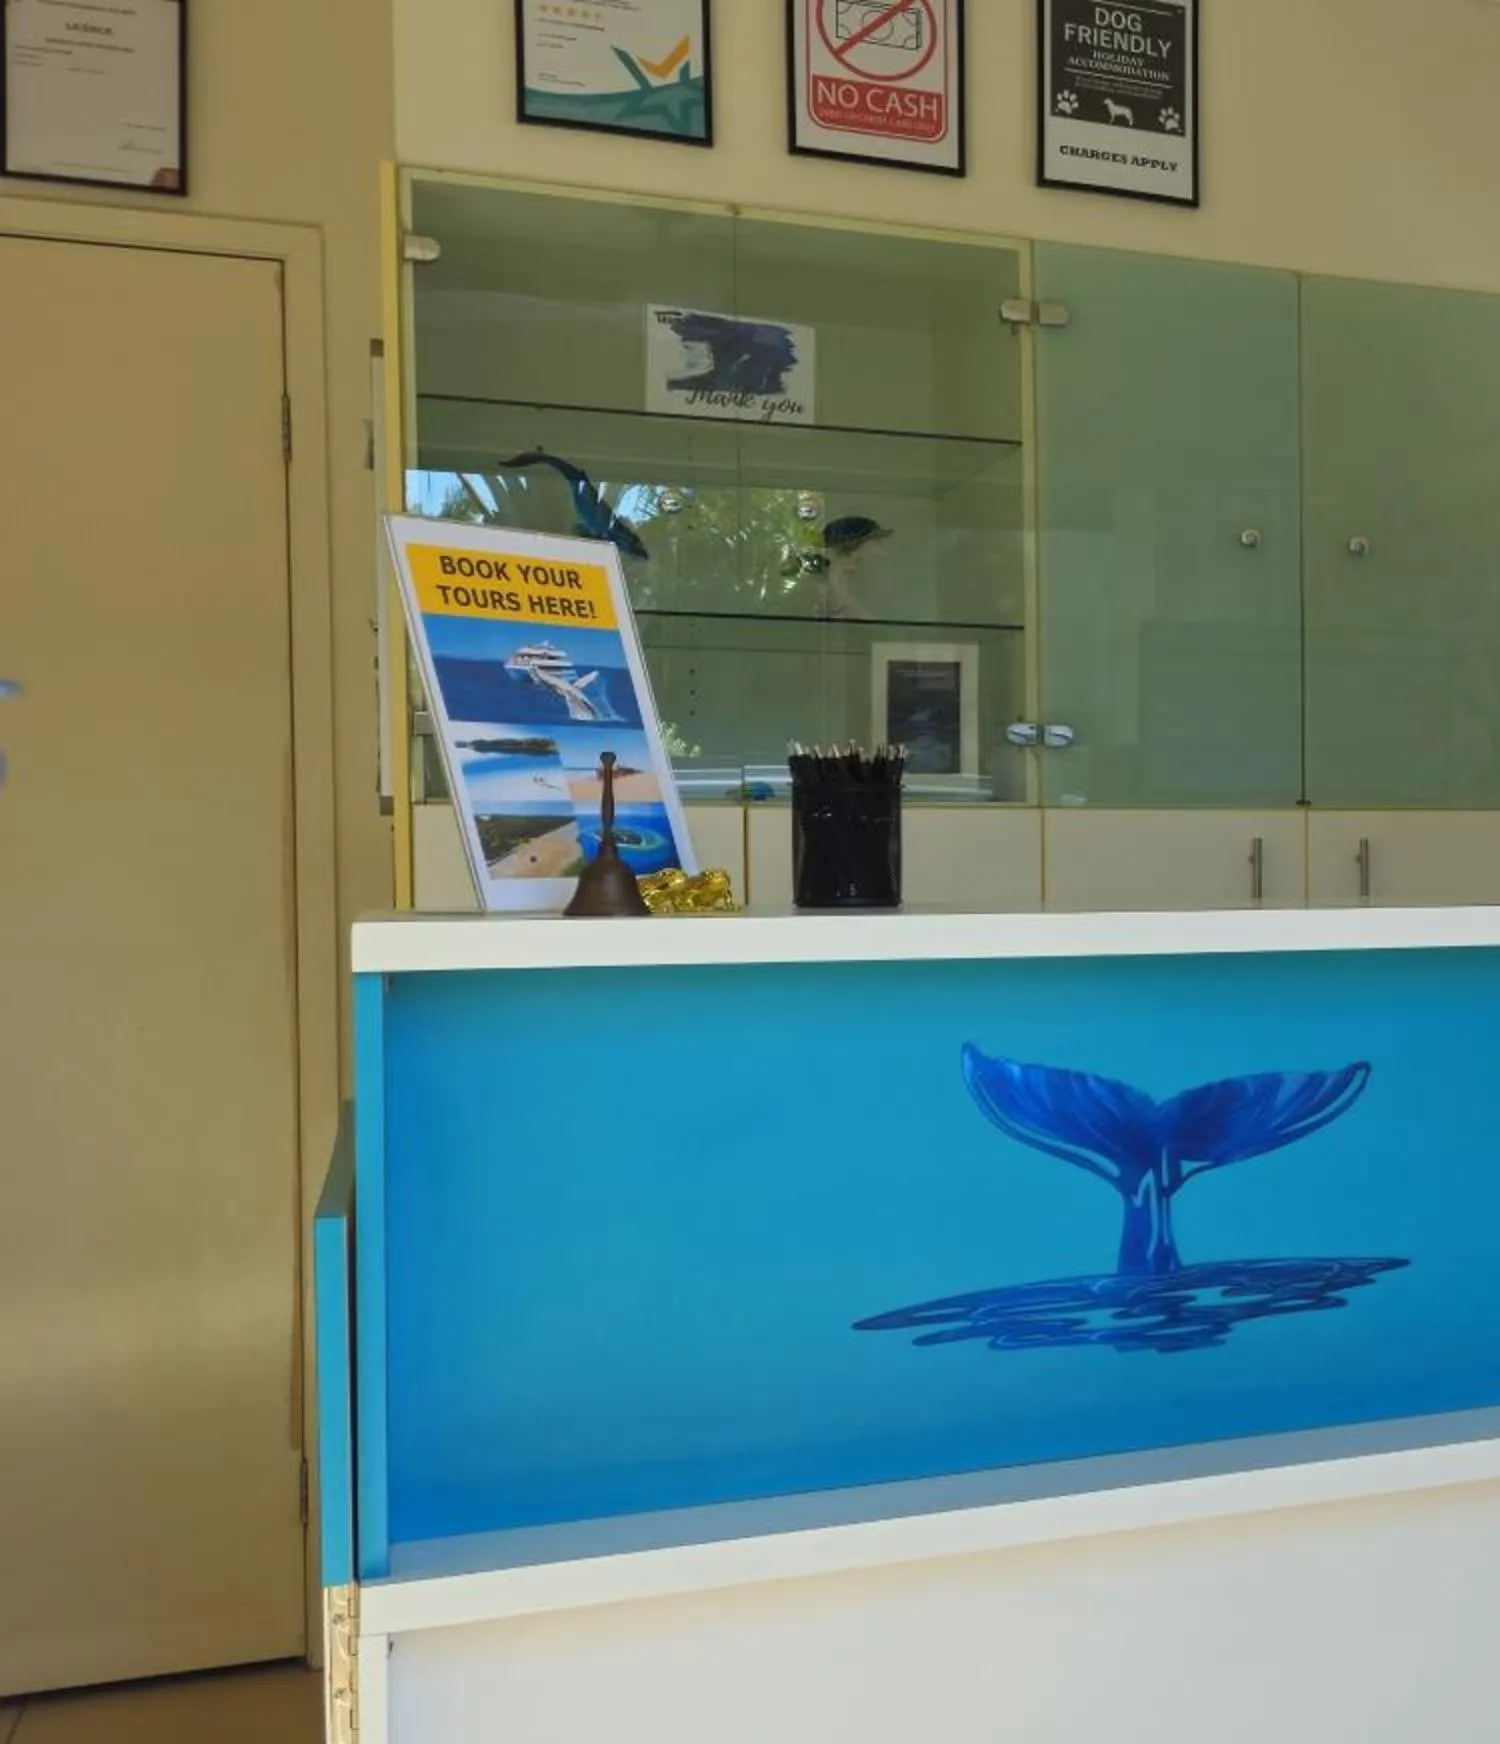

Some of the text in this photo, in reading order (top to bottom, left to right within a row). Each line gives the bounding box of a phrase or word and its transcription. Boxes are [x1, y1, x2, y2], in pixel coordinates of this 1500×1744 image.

[1095, 7, 1143, 33] DOG
[1063, 22, 1173, 59] FRIENDLY
[1093, 49, 1145, 67] HOLIDAY
[817, 80, 938, 121] NO CASH
[1059, 145, 1179, 172] CHARGES APPLY
[761, 398, 804, 421] you
[439, 555, 582, 590] BOOK YOUR
[435, 584, 600, 619] TOURS HERE!
